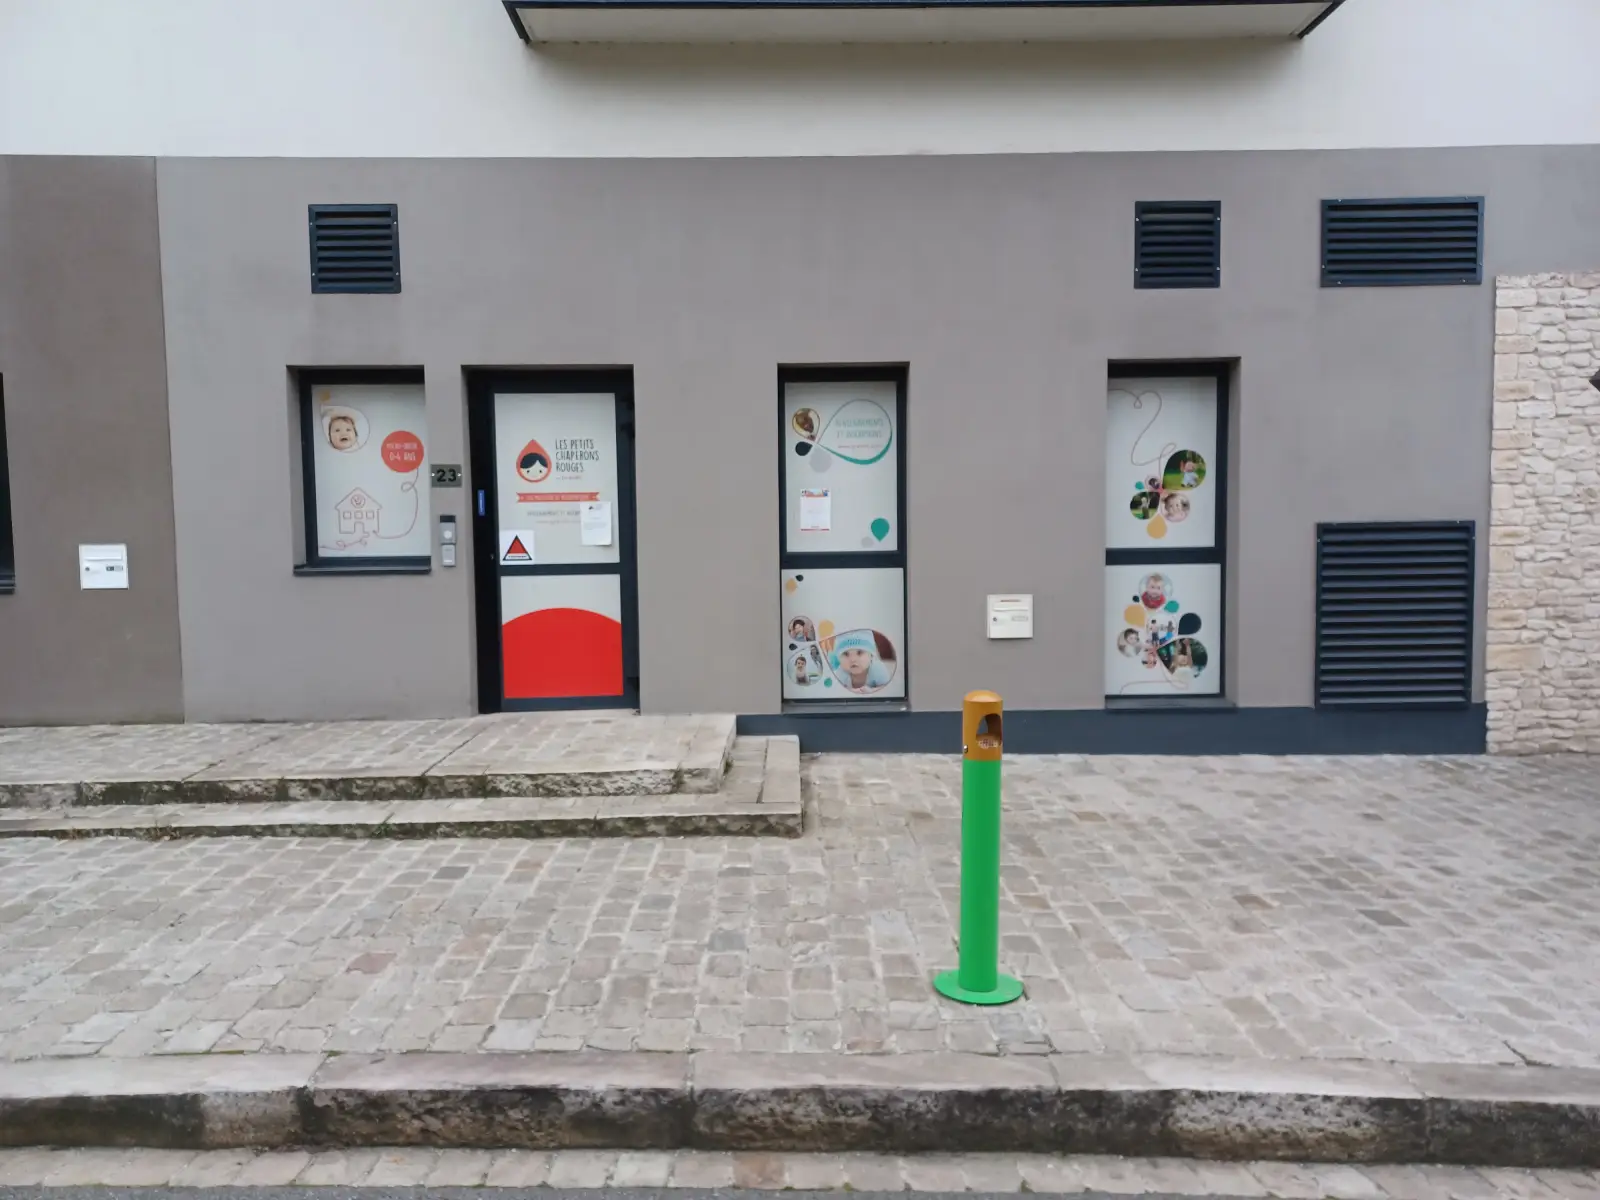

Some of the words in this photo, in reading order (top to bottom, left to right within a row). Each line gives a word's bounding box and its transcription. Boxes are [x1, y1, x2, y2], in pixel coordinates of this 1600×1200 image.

[555, 438, 567, 450] LES
[570, 438, 594, 450] PETITS
[555, 450, 600, 461] CHAPERONS
[556, 462, 584, 472] ROUGES
[436, 468, 457, 482] 23
